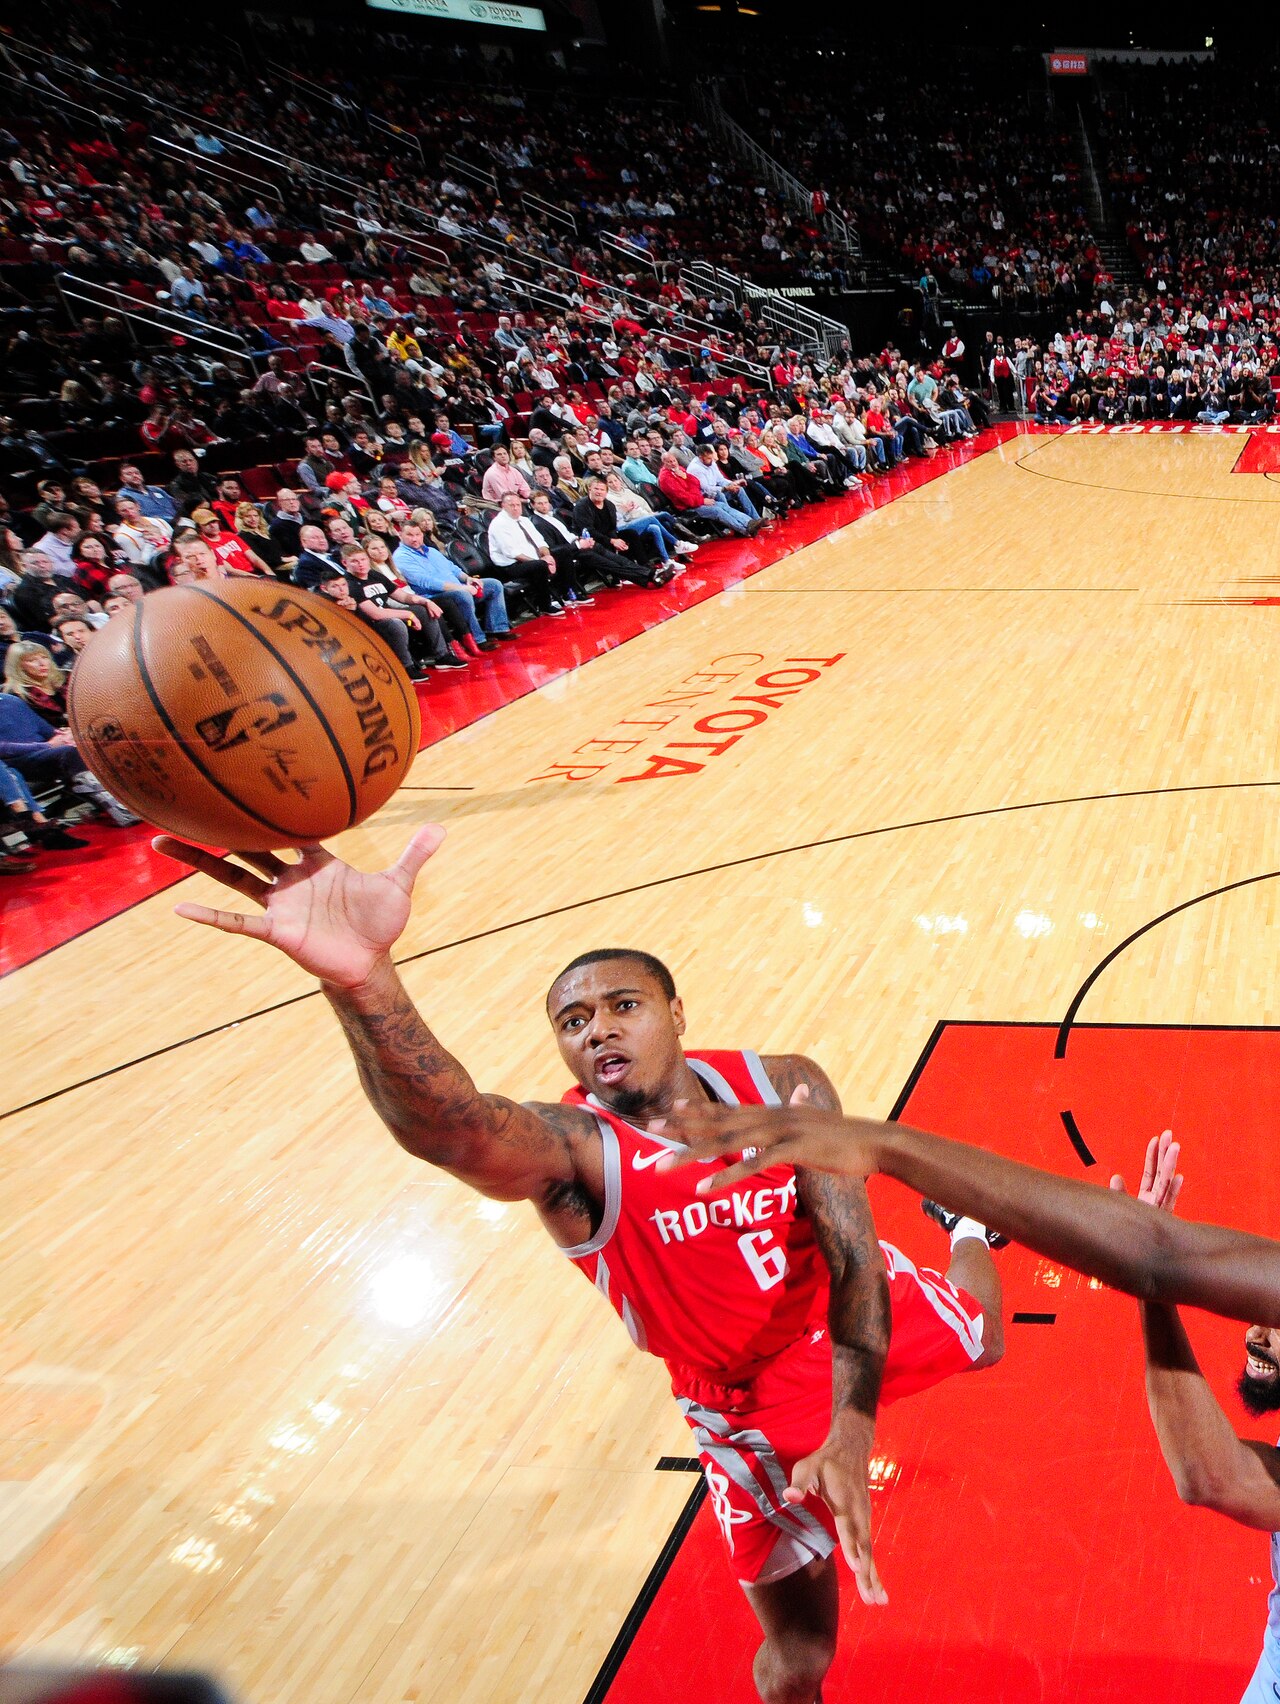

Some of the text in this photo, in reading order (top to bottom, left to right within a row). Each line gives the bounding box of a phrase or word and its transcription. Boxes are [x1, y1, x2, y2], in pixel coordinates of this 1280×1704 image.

[488, 6, 522, 18] TOYOTA
[780, 287, 816, 297] TUNNEL
[251, 598, 399, 784] SPALDING
[525, 652, 765, 784] CENTER
[614, 652, 848, 784] TOYOTA
[737, 1229, 790, 1291] 6
